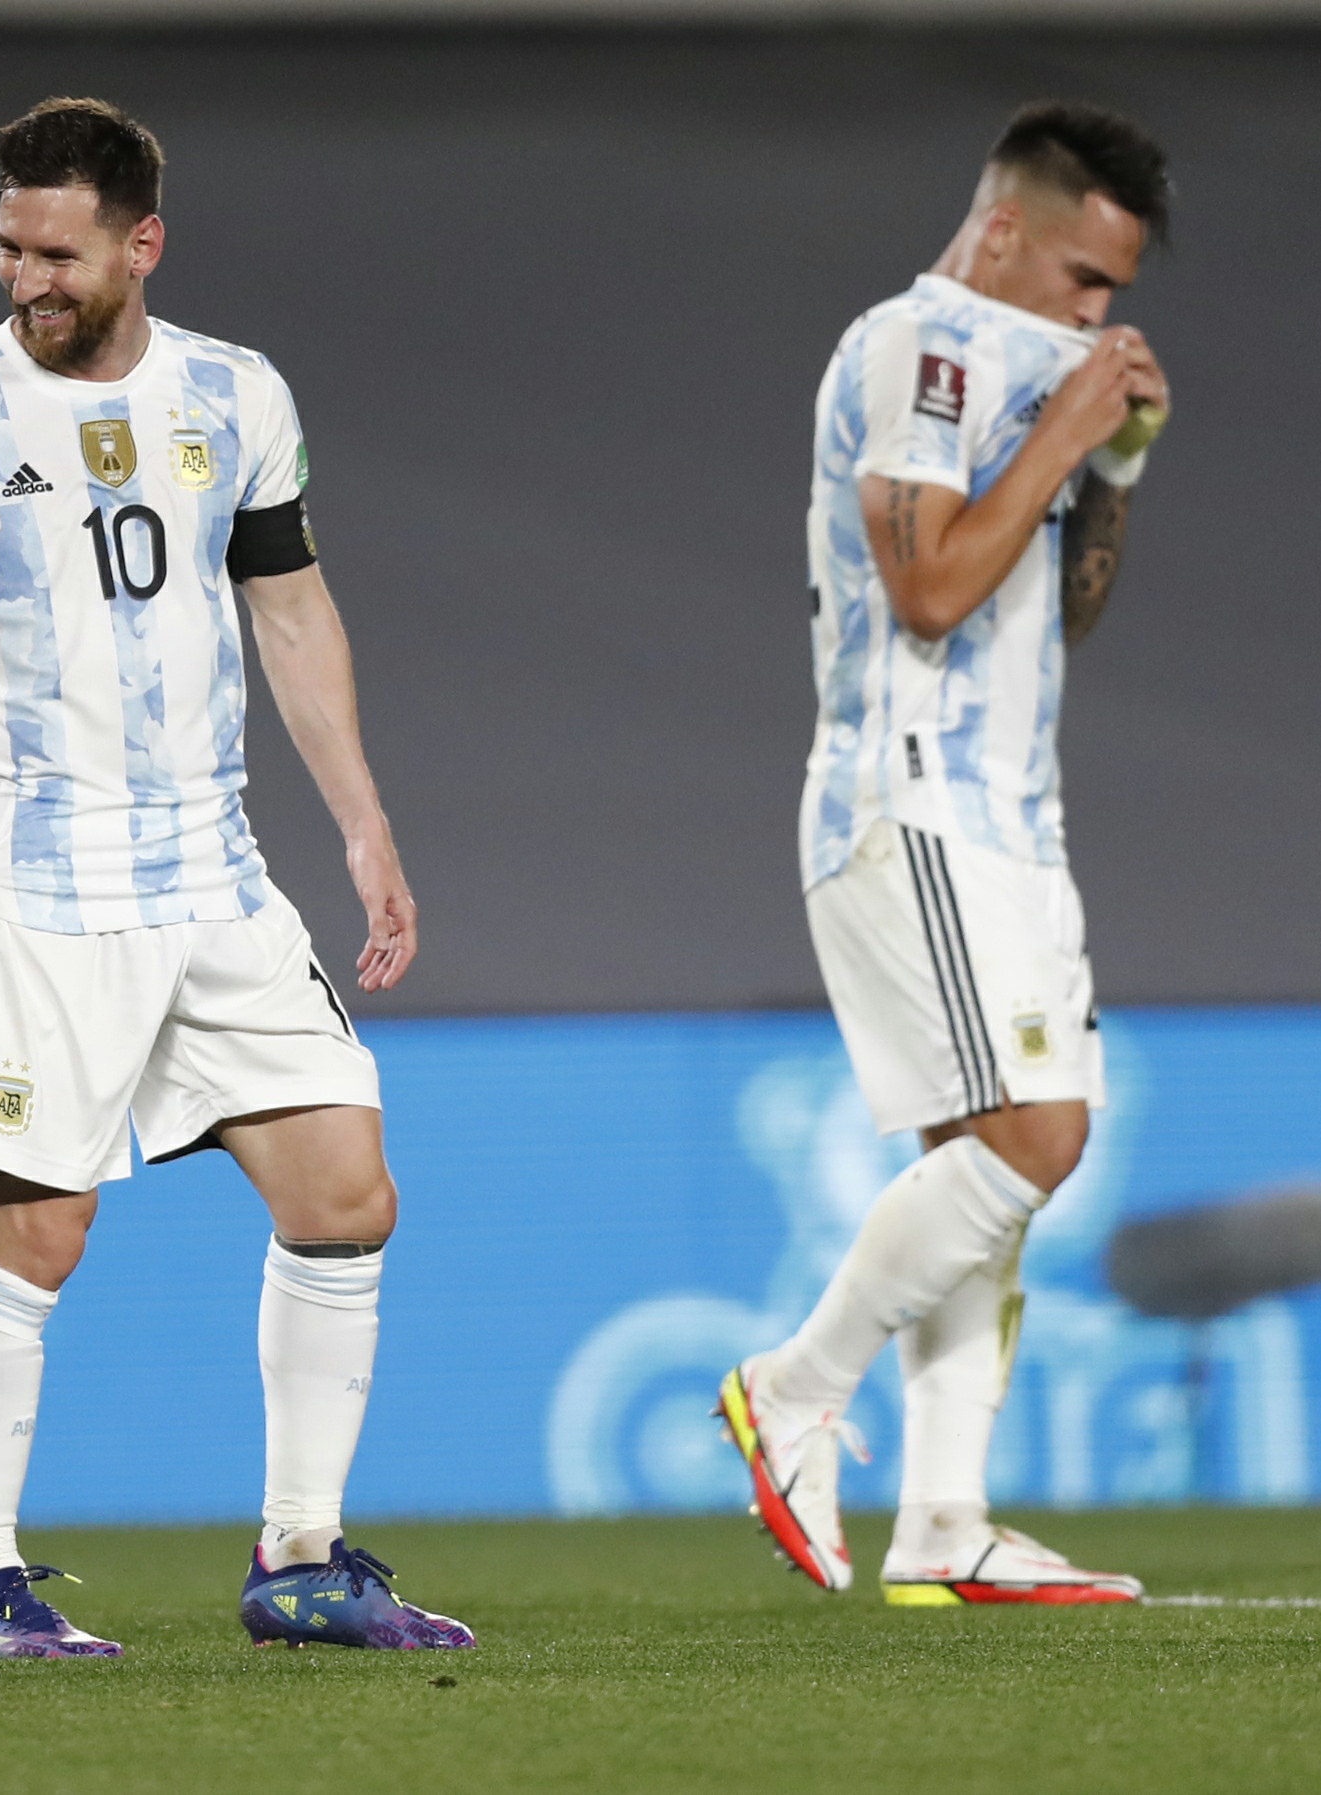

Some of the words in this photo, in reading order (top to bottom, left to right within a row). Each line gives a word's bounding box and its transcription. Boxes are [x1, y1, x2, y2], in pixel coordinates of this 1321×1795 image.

[182, 444, 208, 474] AFA
[2, 482, 54, 498] adidas
[81, 503, 168, 601] 10
[272, 1595, 297, 1620] adidas
